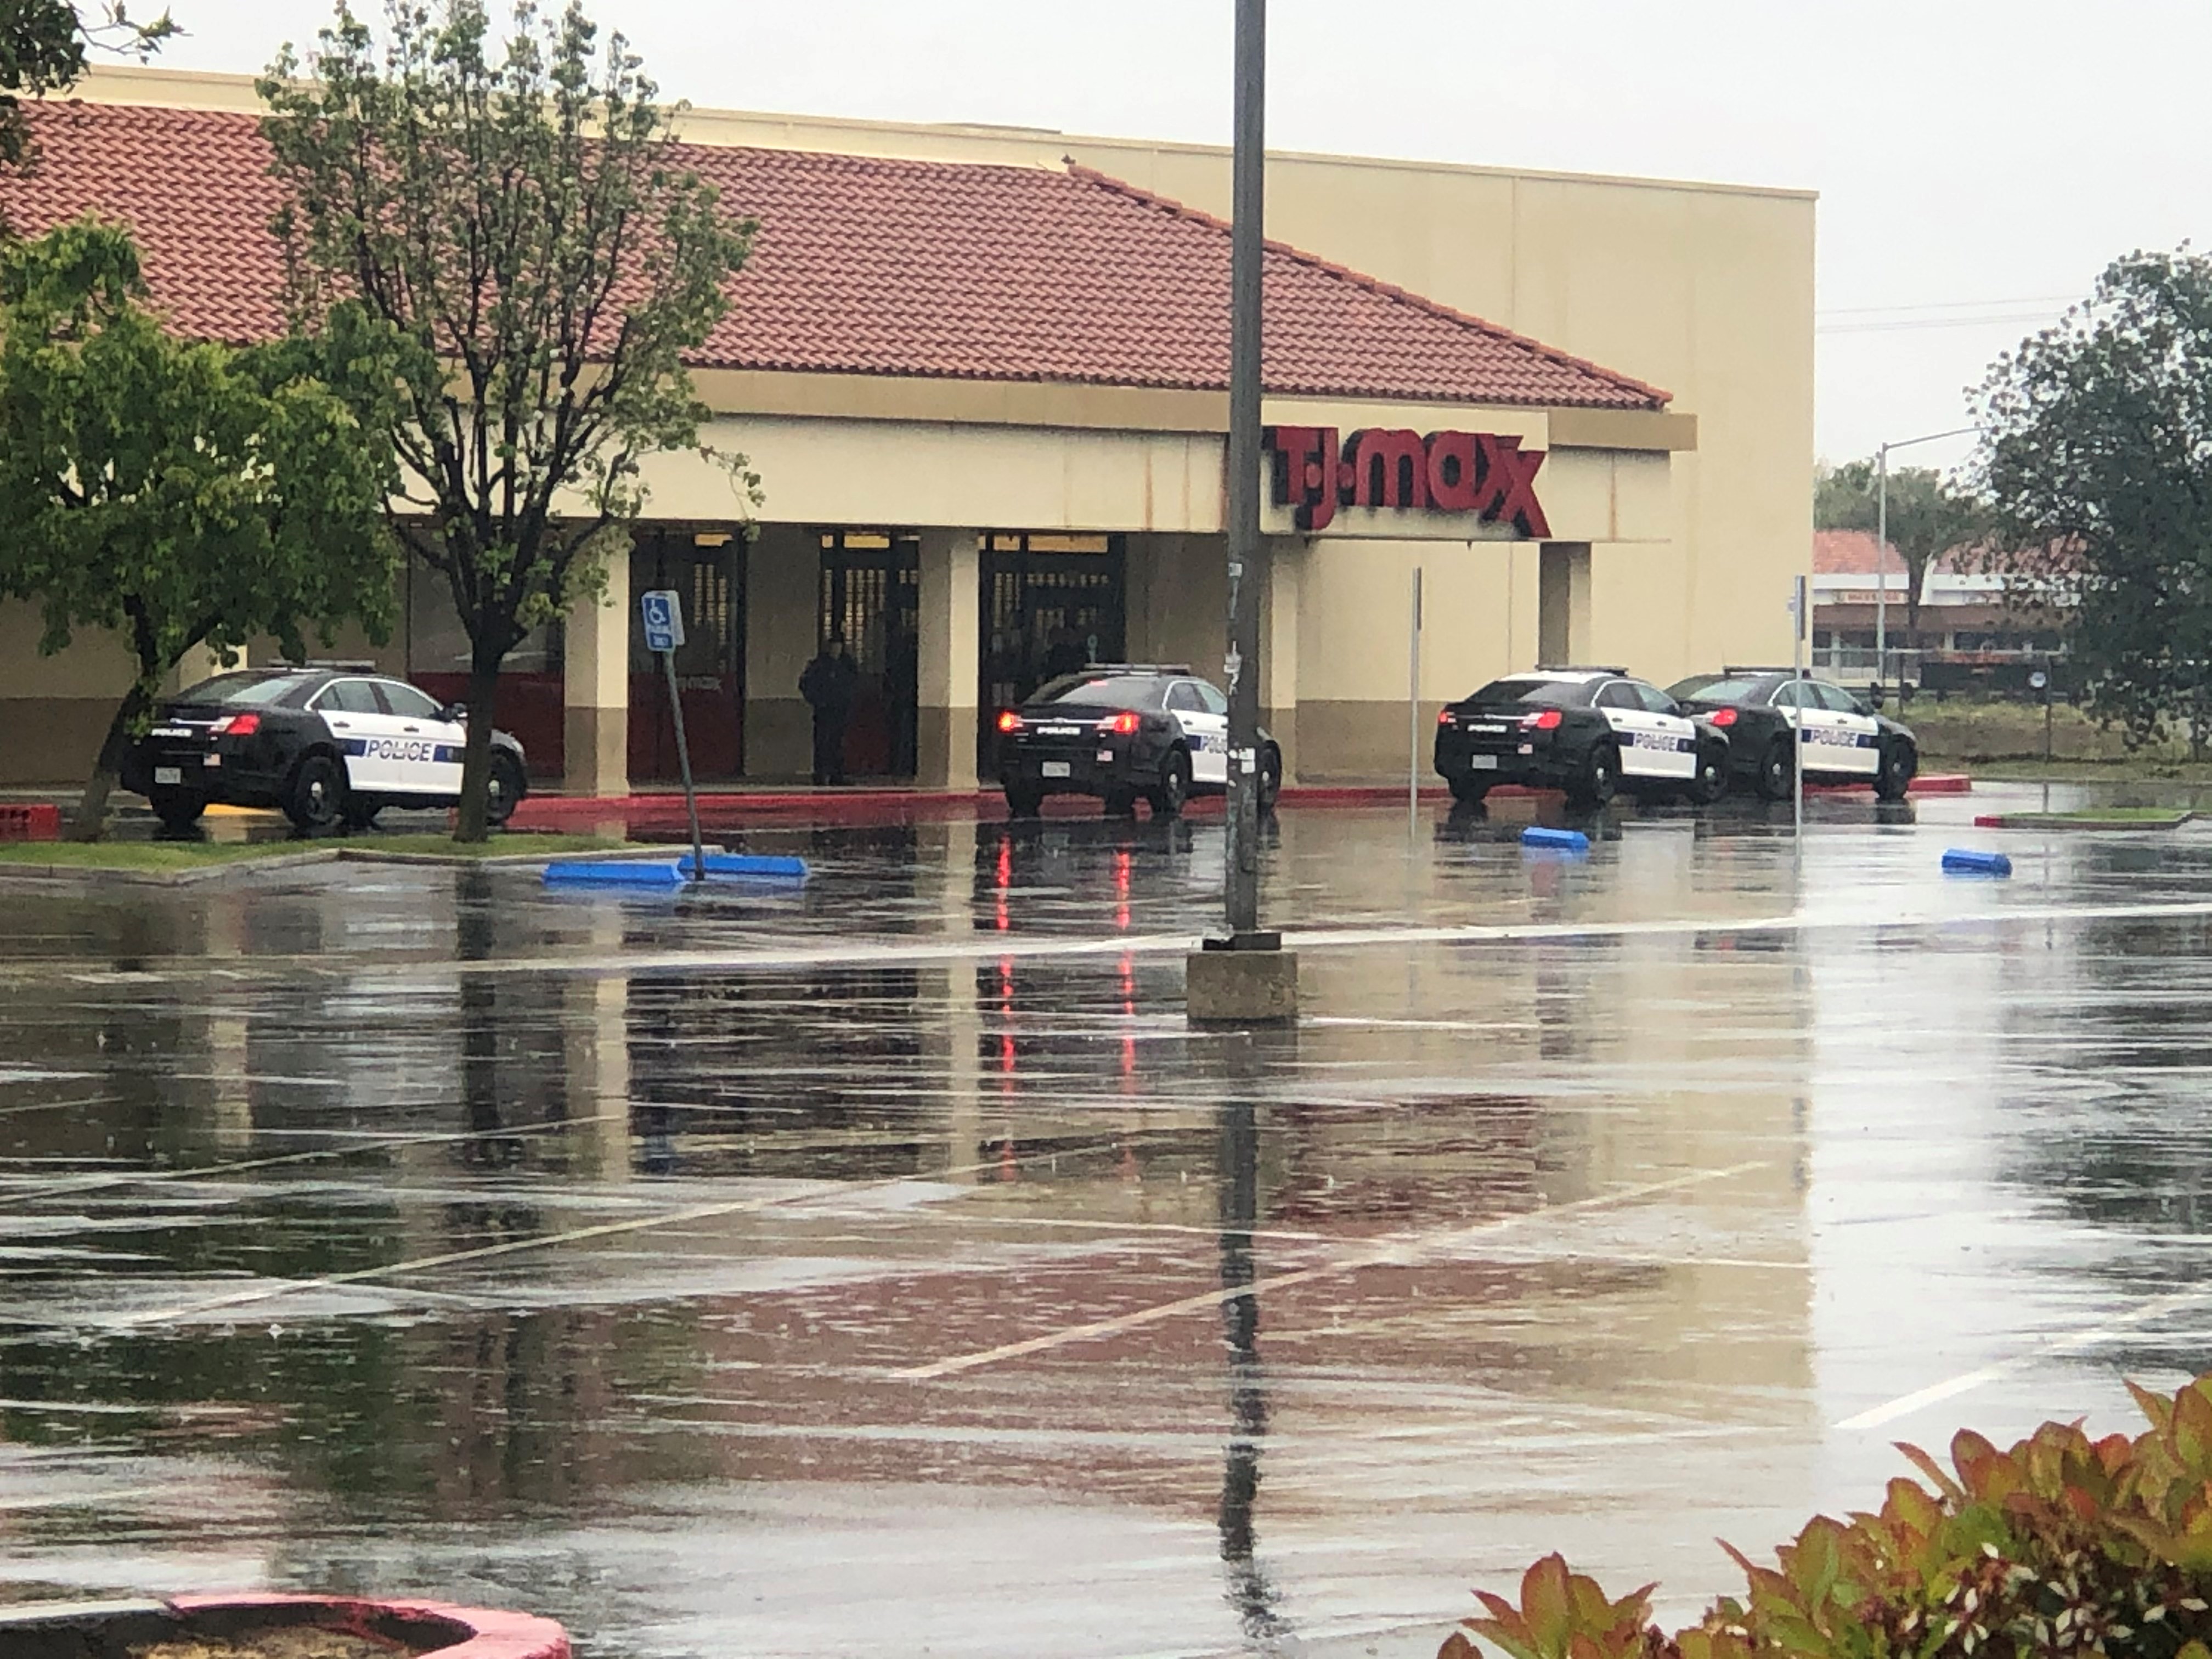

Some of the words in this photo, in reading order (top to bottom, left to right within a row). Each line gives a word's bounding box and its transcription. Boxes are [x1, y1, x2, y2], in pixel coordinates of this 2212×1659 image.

[1635, 732, 1677, 752] POLICE
[1811, 729, 1856, 748] POLICE
[366, 740, 432, 761] POLICE
